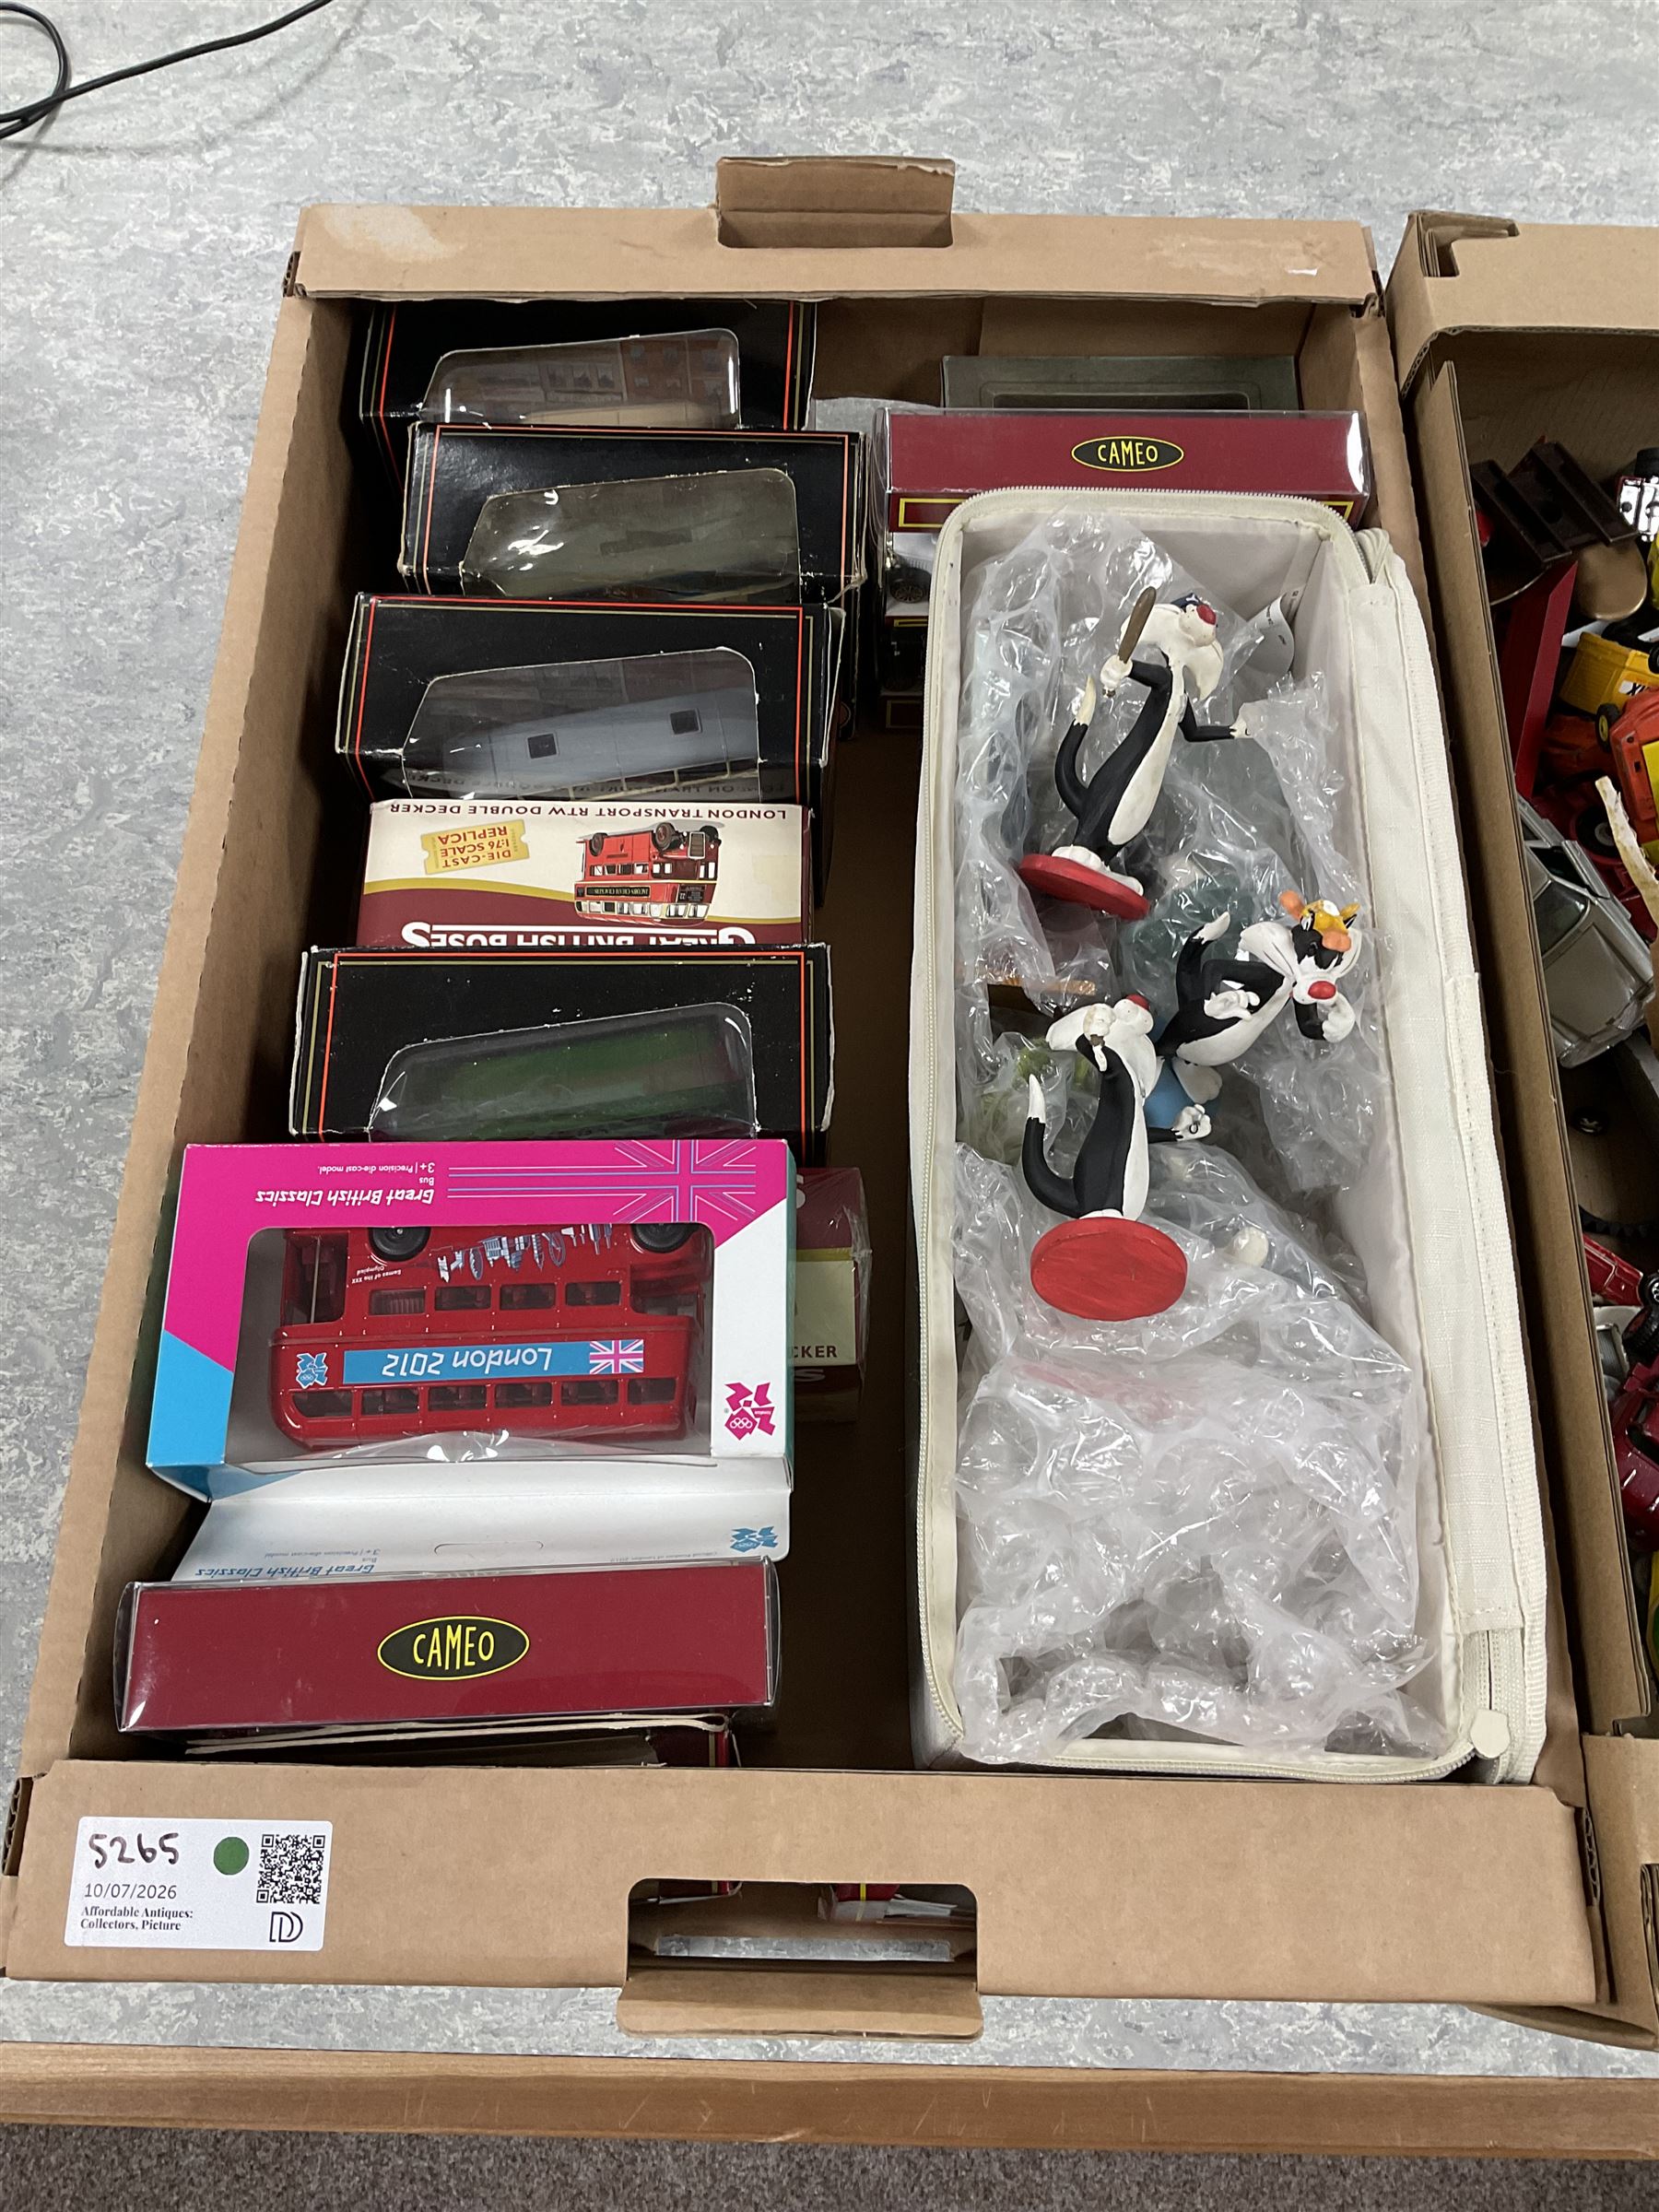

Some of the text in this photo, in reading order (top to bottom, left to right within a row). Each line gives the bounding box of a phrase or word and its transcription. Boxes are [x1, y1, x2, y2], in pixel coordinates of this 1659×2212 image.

[1098, 441, 1159, 466] CAMEO
[390, 804, 786, 819] LONDON TRANSPORT RTW DOUBLE DECKER
[438, 826, 508, 845] REPLICA
[441, 841, 485, 857] SCALE
[442, 849, 512, 868] DIE-CAST
[318, 1162, 436, 1175] 3+ Precision die-cast model.
[419, 1177, 435, 1185] Bus
[255, 1189, 435, 1207] Great British Classics
[382, 1347, 552, 1377] London 2012
[194, 1564, 375, 1579] Great British Classics
[413, 1624, 495, 1670] CAMEO
[88, 1832, 180, 1869] 5265
[84, 1883, 177, 1900] 10/07/2026
[81, 1906, 139, 1918] Affordable
[141, 1920, 182, 1931] Picture
